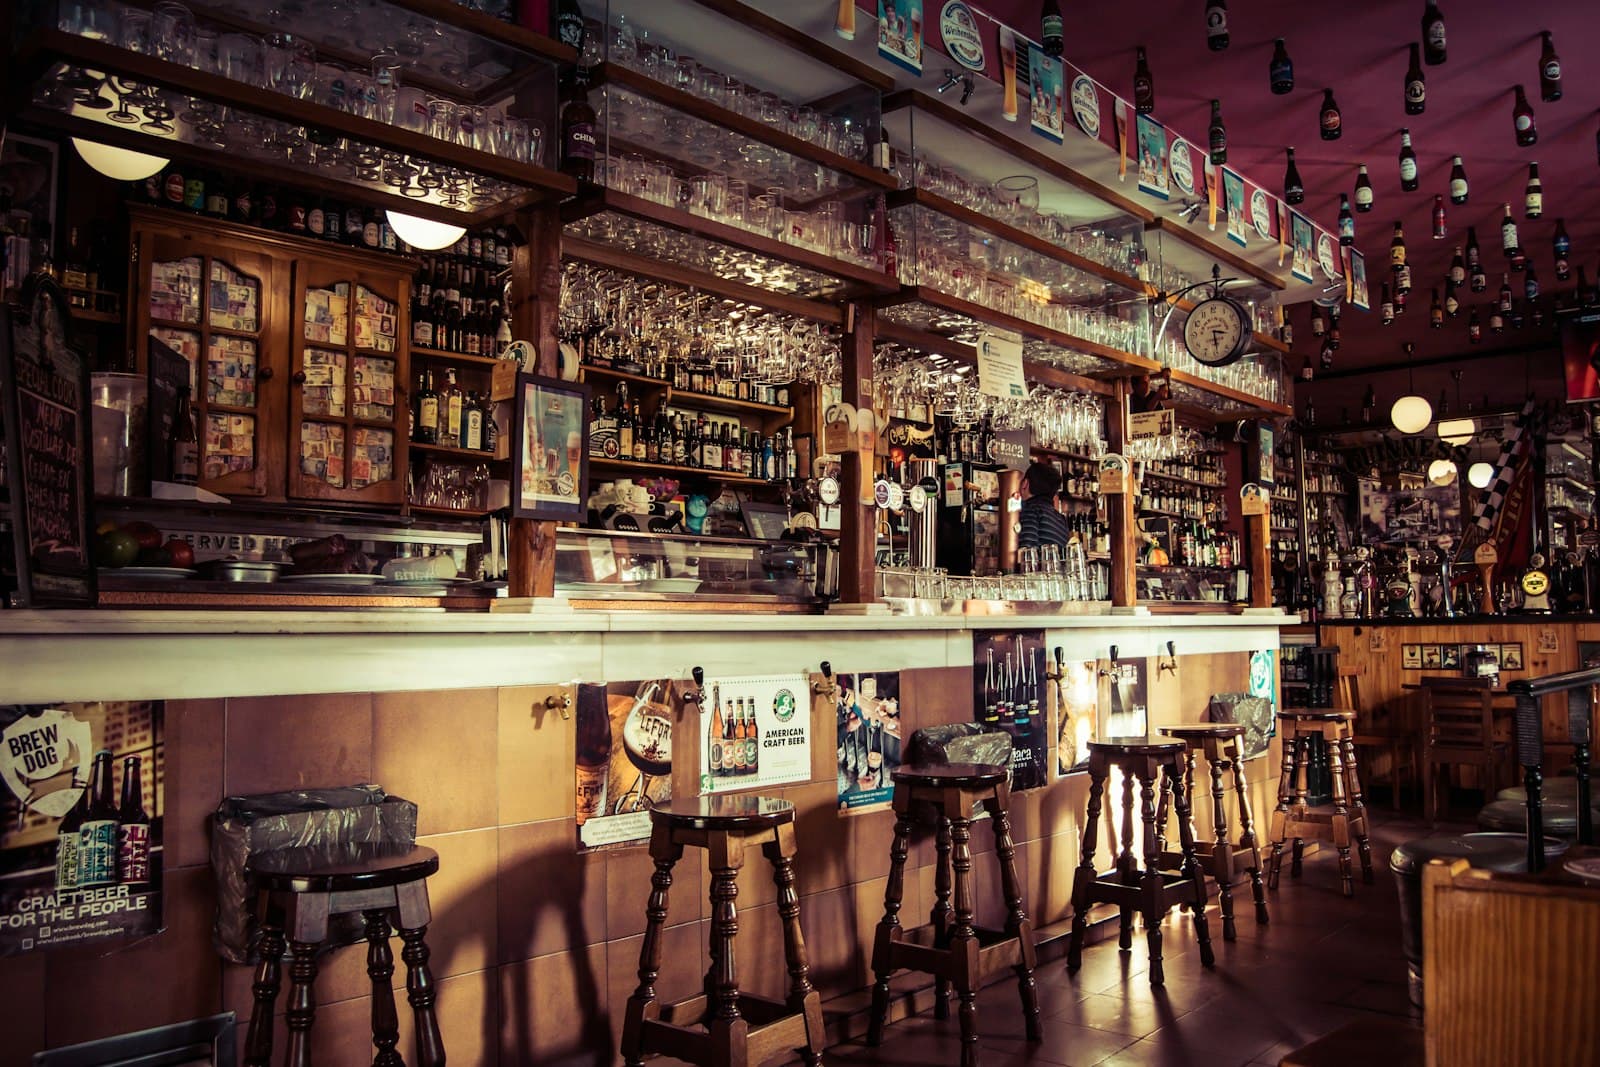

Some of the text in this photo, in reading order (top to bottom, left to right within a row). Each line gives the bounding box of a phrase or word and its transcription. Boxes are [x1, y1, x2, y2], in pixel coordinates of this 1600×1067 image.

[8, 724, 58, 758] BREW
[640, 714, 673, 742] LEFOR
[763, 736, 806, 748] CRAFT BEER
[765, 728, 804, 738] AMERICAN
[23, 746, 59, 773] DOG
[96, 824, 107, 881] PUNK IPA
[0, 895, 147, 929] FOR THE PEOPLE
[18, 884, 130, 912] CRAFT BEER
